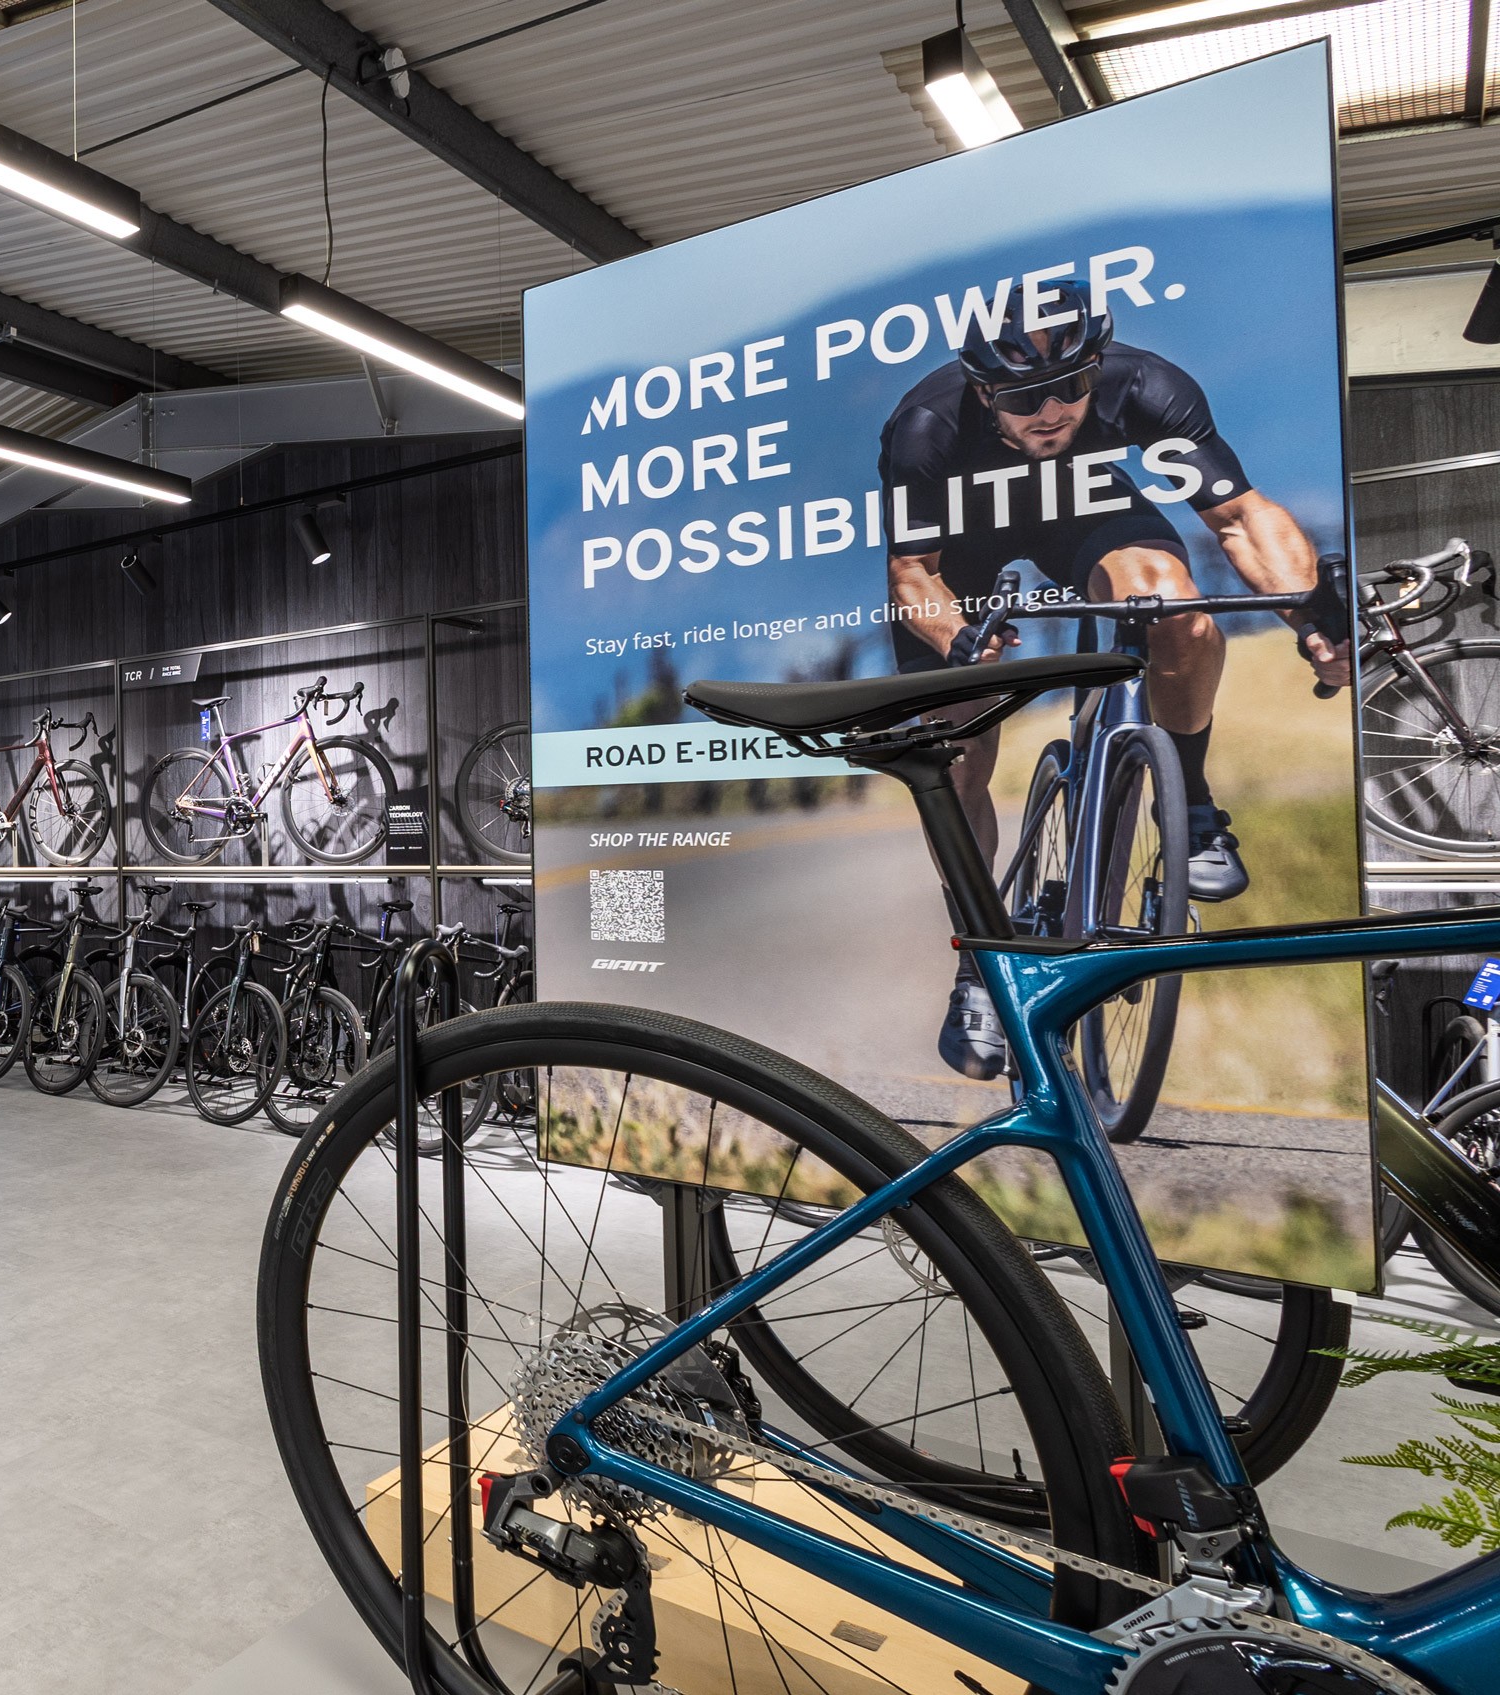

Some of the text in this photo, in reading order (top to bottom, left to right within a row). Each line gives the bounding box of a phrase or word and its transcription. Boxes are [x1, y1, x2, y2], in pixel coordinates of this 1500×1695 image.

[581, 245, 1187, 436] MORE POWER.
[581, 420, 791, 513] MORE
[583, 436, 1235, 590] POSSIBILITIES.
[585, 584, 1082, 657] Stay fast, ride longer and climb stronger.
[125, 671, 142, 681] TCR
[586, 743, 666, 768] ROAD
[589, 831, 732, 848] SHOP THE RANGE
[591, 958, 666, 972] GIANT
[1123, 1610, 1155, 1631] SRAM
[1164, 1650, 1190, 1666] SRAM
